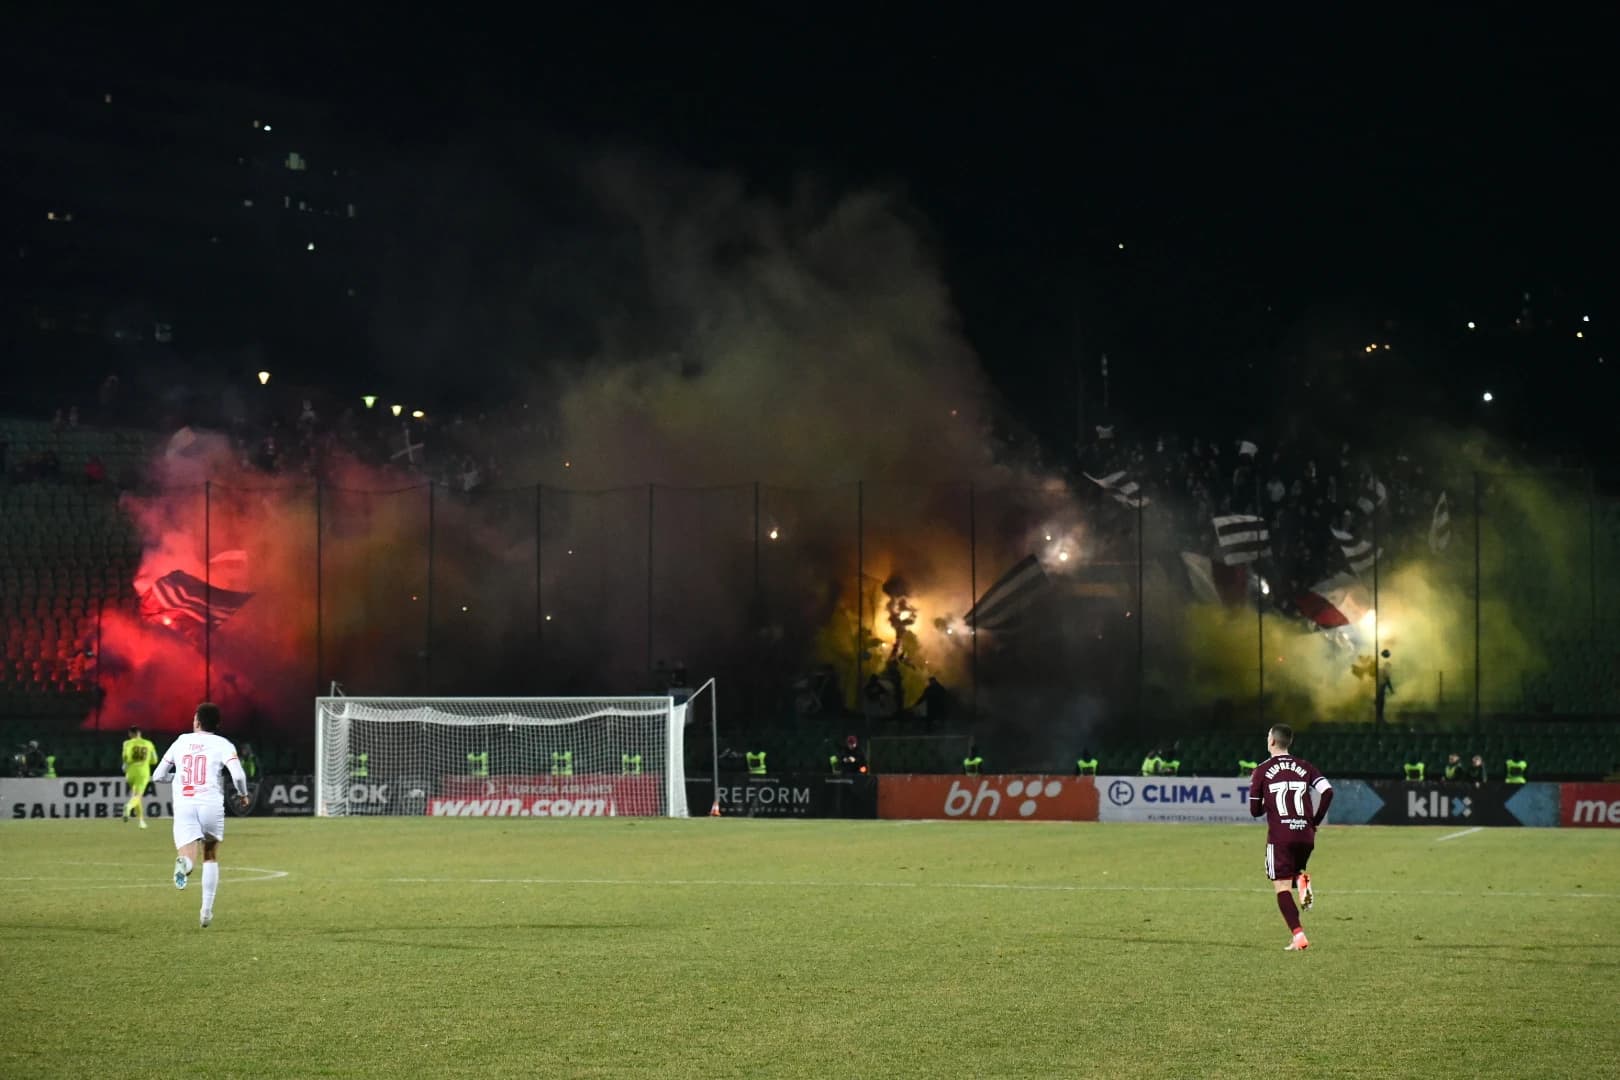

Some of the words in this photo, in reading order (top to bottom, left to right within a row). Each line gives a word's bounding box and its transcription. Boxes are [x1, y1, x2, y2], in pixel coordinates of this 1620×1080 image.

[183, 754, 206, 785] 30
[63, 781, 157, 797] OPTIA
[717, 786, 810, 804] REFORM
[944, 780, 1001, 816] bh
[1142, 784, 1215, 803] CLIMA
[1268, 781, 1307, 816] 77
[12, 802, 173, 818] SALIHBEO
